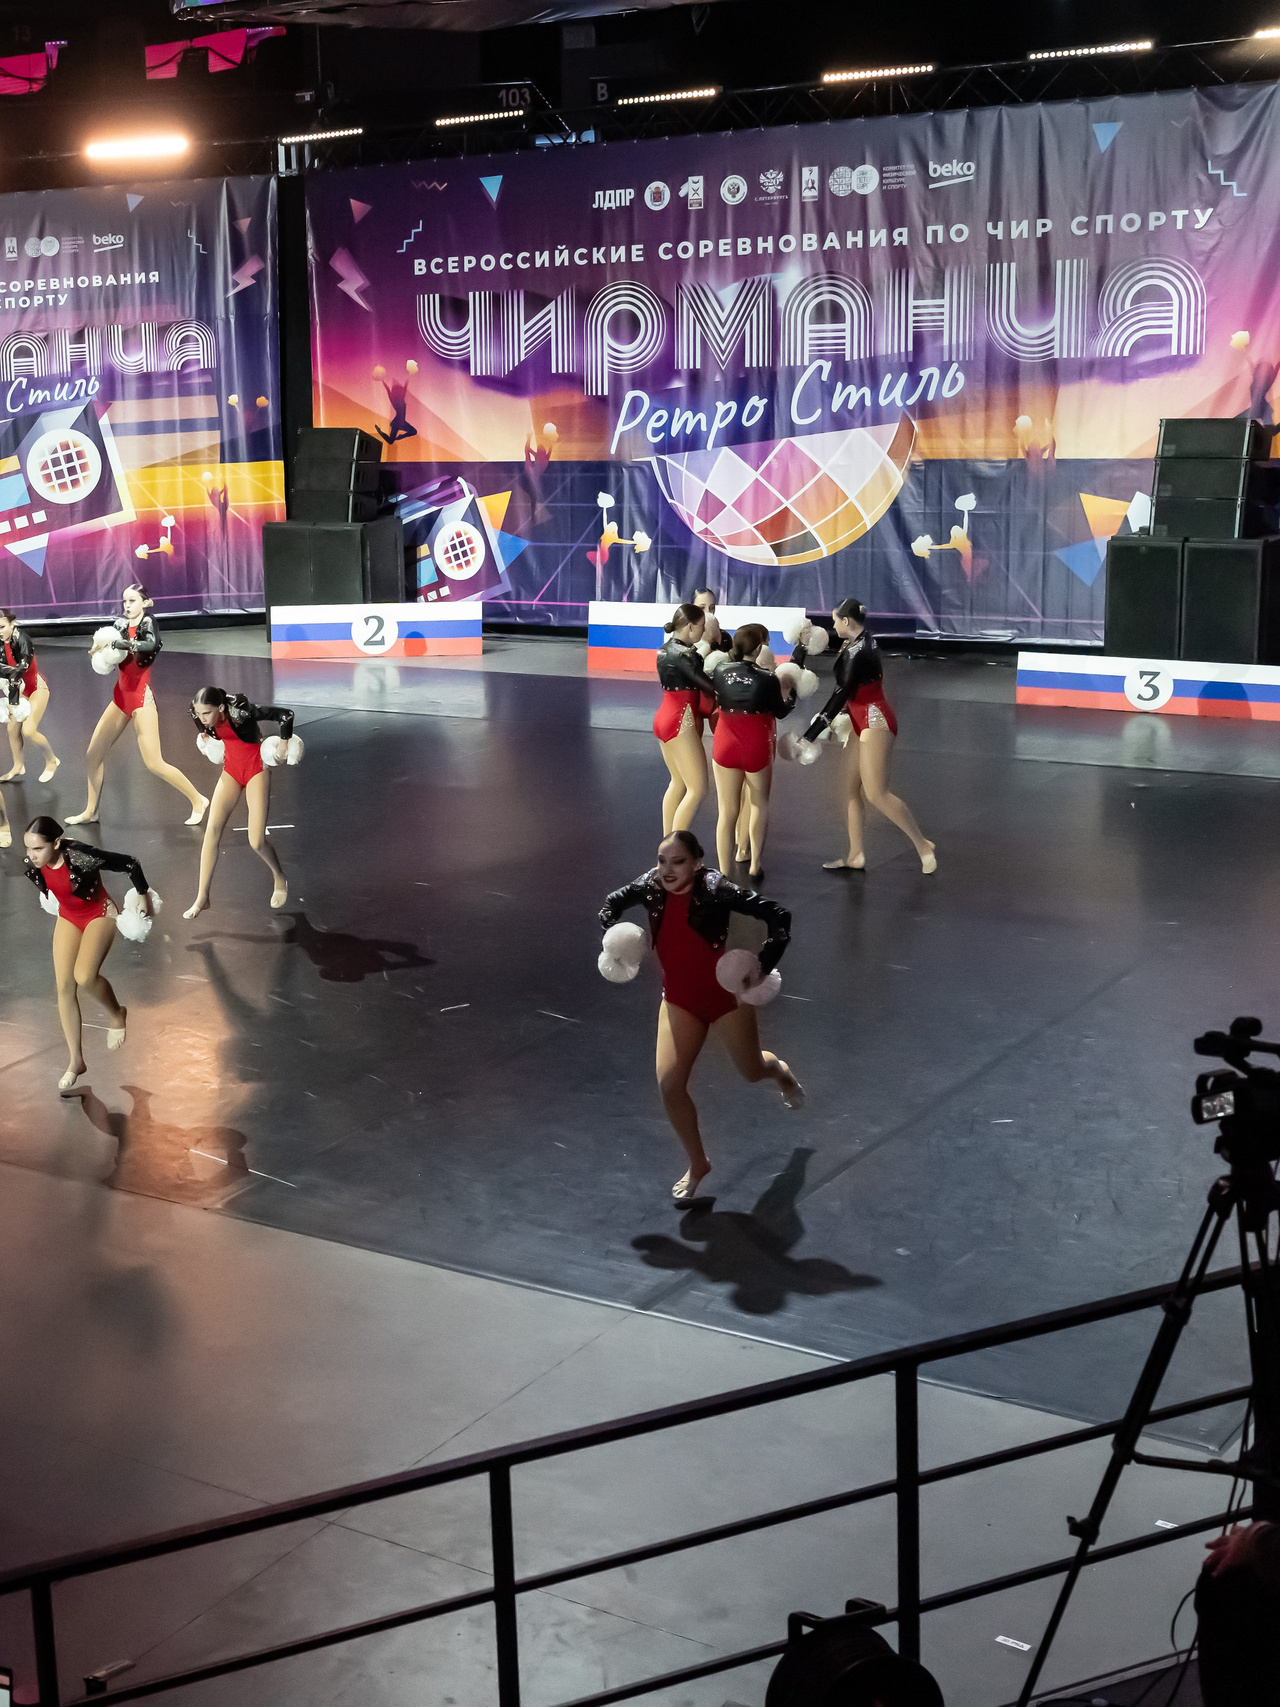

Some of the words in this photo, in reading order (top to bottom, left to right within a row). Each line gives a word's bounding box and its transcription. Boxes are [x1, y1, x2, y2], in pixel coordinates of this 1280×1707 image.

[12, 24, 33, 43] 13
[498, 87, 532, 108] 103
[928, 159, 976, 178] beko
[592, 188, 635, 211] ЛДПР
[92, 233, 125, 246] beko
[413, 243, 645, 276] ВСЕРОССИЙСКИЕ
[657, 226, 909, 261] СОРЕВНОВАНИЯ
[925, 222, 971, 245] ПО
[985, 217, 1054, 241] ЧИР
[1070, 207, 1215, 237] СПОРТУ
[6, 374, 101, 414] Стиль
[609, 388, 769, 455] Ретро
[790, 359, 966, 425] Стиль
[363, 615, 386, 646] 2
[1136, 670, 1161, 701] 3
